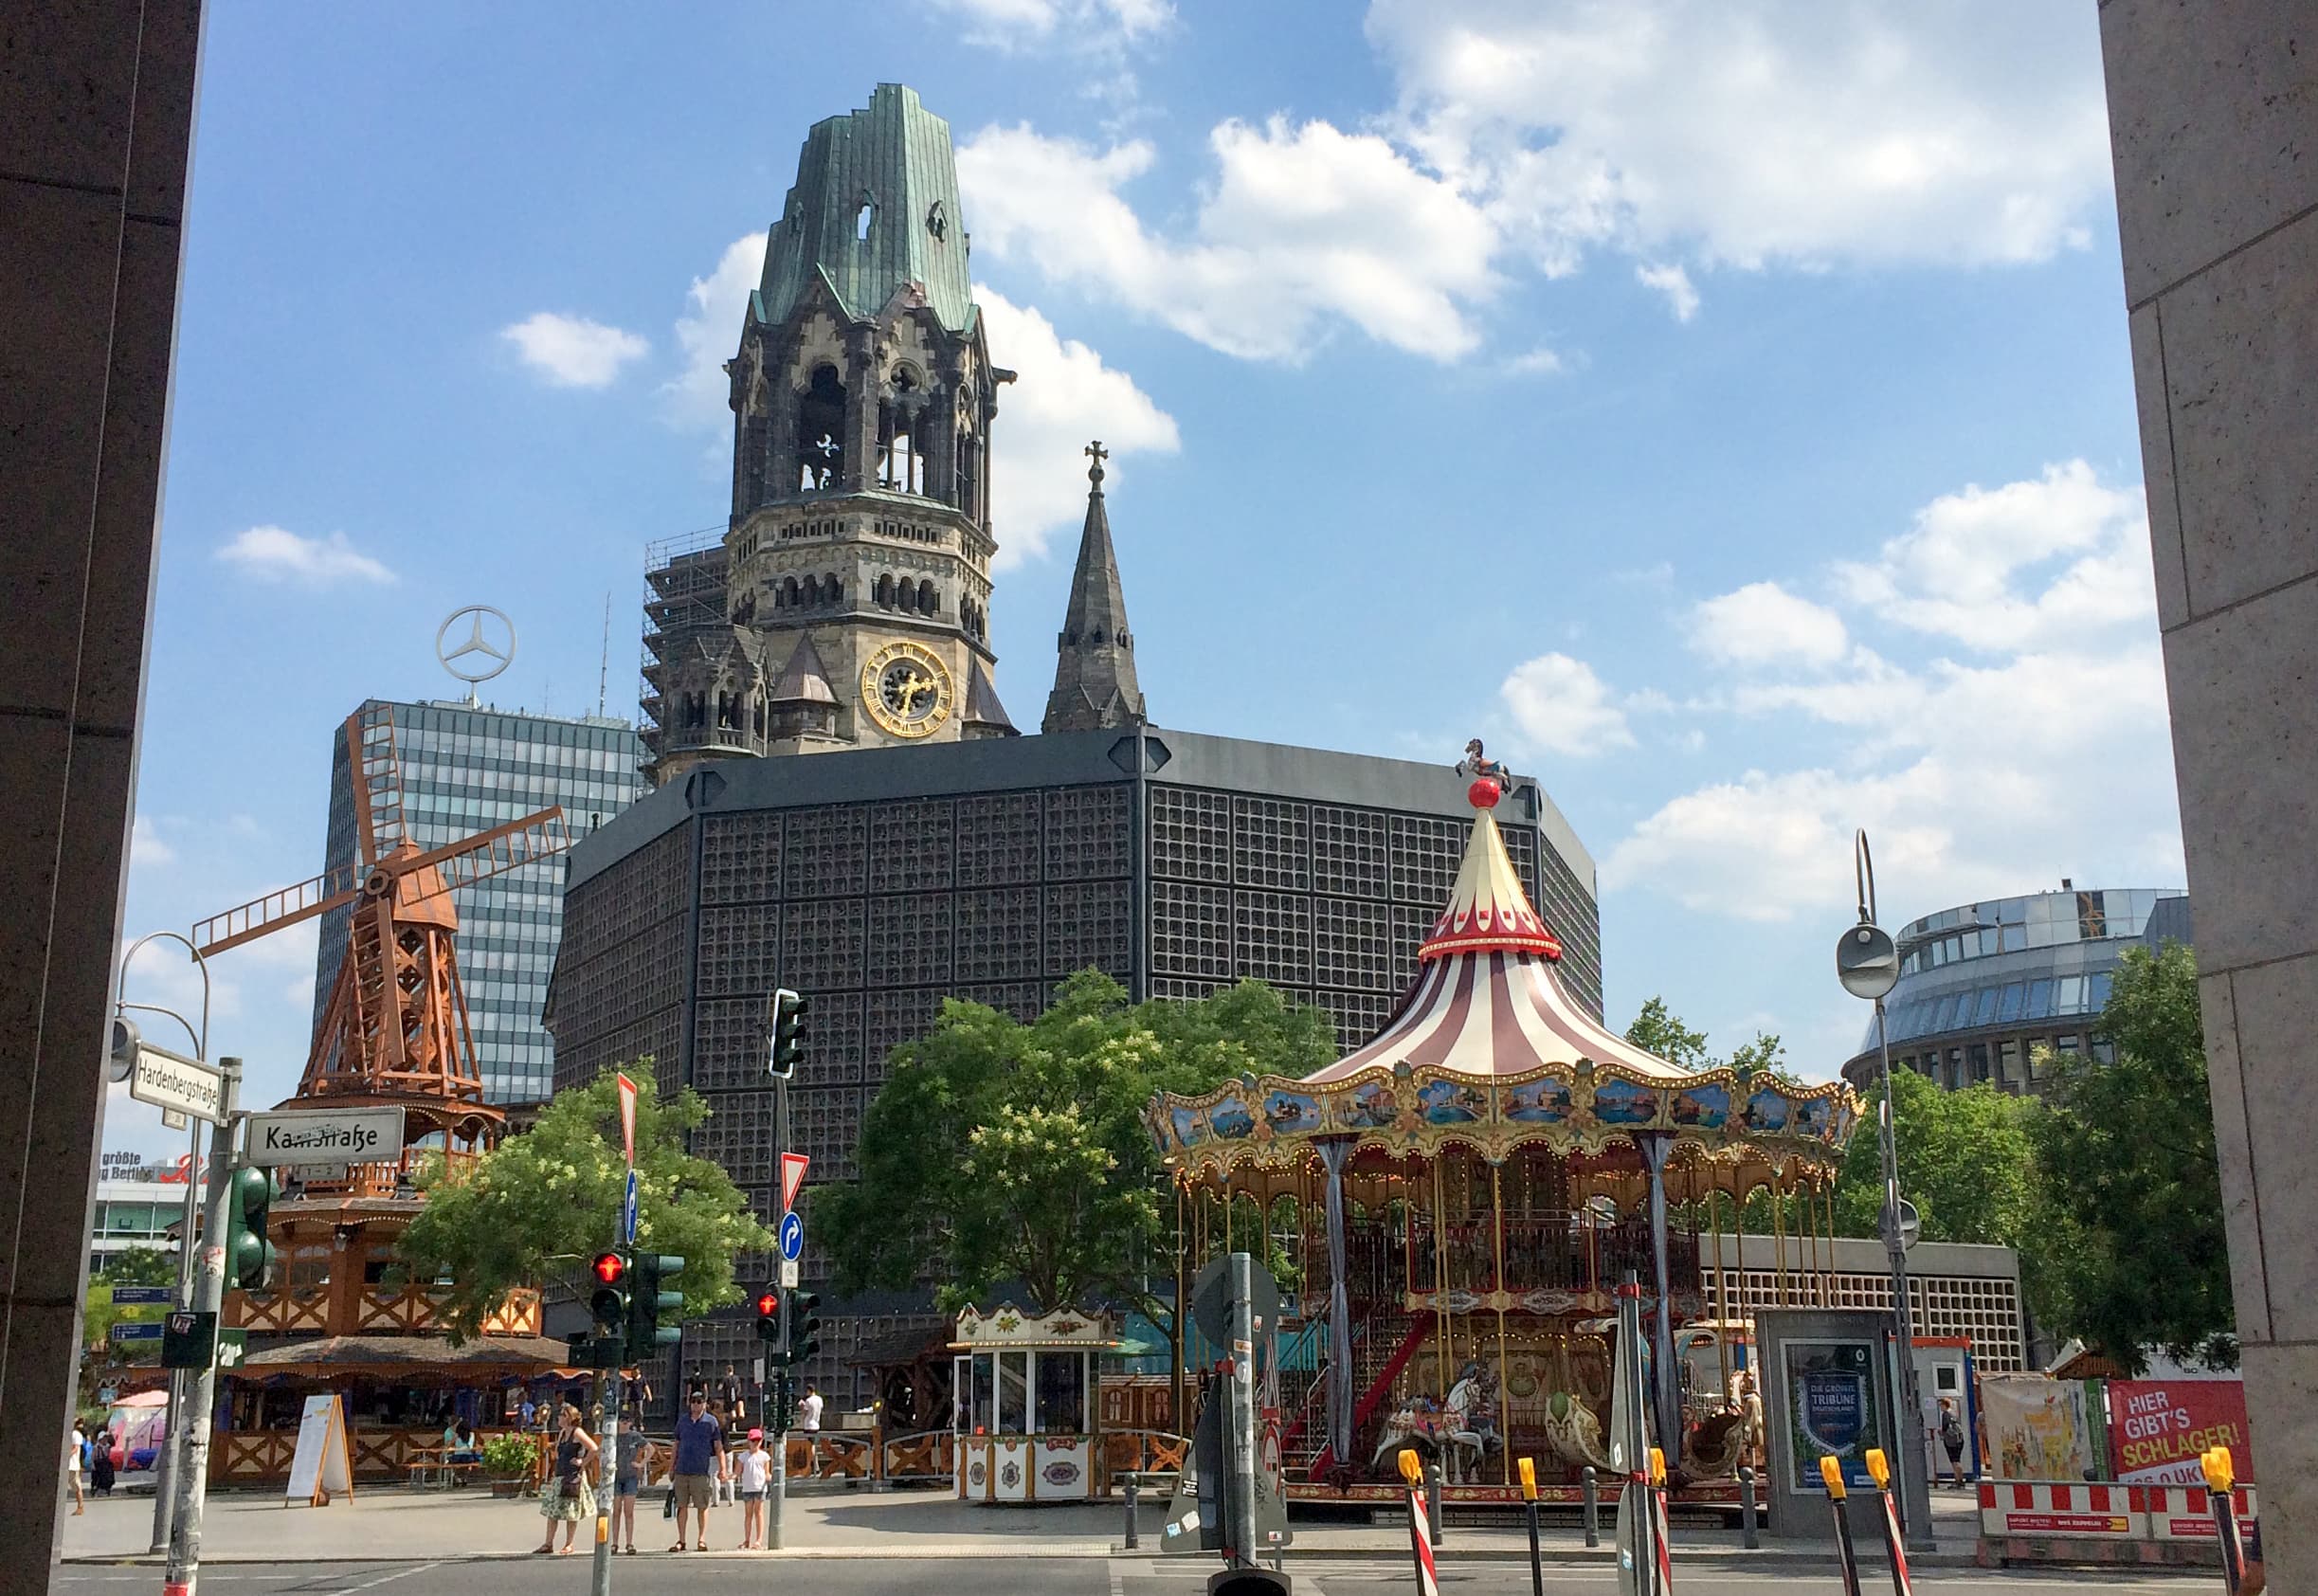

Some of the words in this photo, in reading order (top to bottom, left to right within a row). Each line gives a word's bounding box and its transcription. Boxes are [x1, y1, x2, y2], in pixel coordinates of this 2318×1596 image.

[137, 1058, 217, 1110] Hardenbergstraße
[102, 1152, 141, 1166] größte
[2128, 1390, 2169, 1414] HIER
[2125, 1407, 2191, 1439] GIBT'S
[2122, 1423, 2241, 1467] SCHLAGER!
[2174, 1465, 2206, 1484] UK
